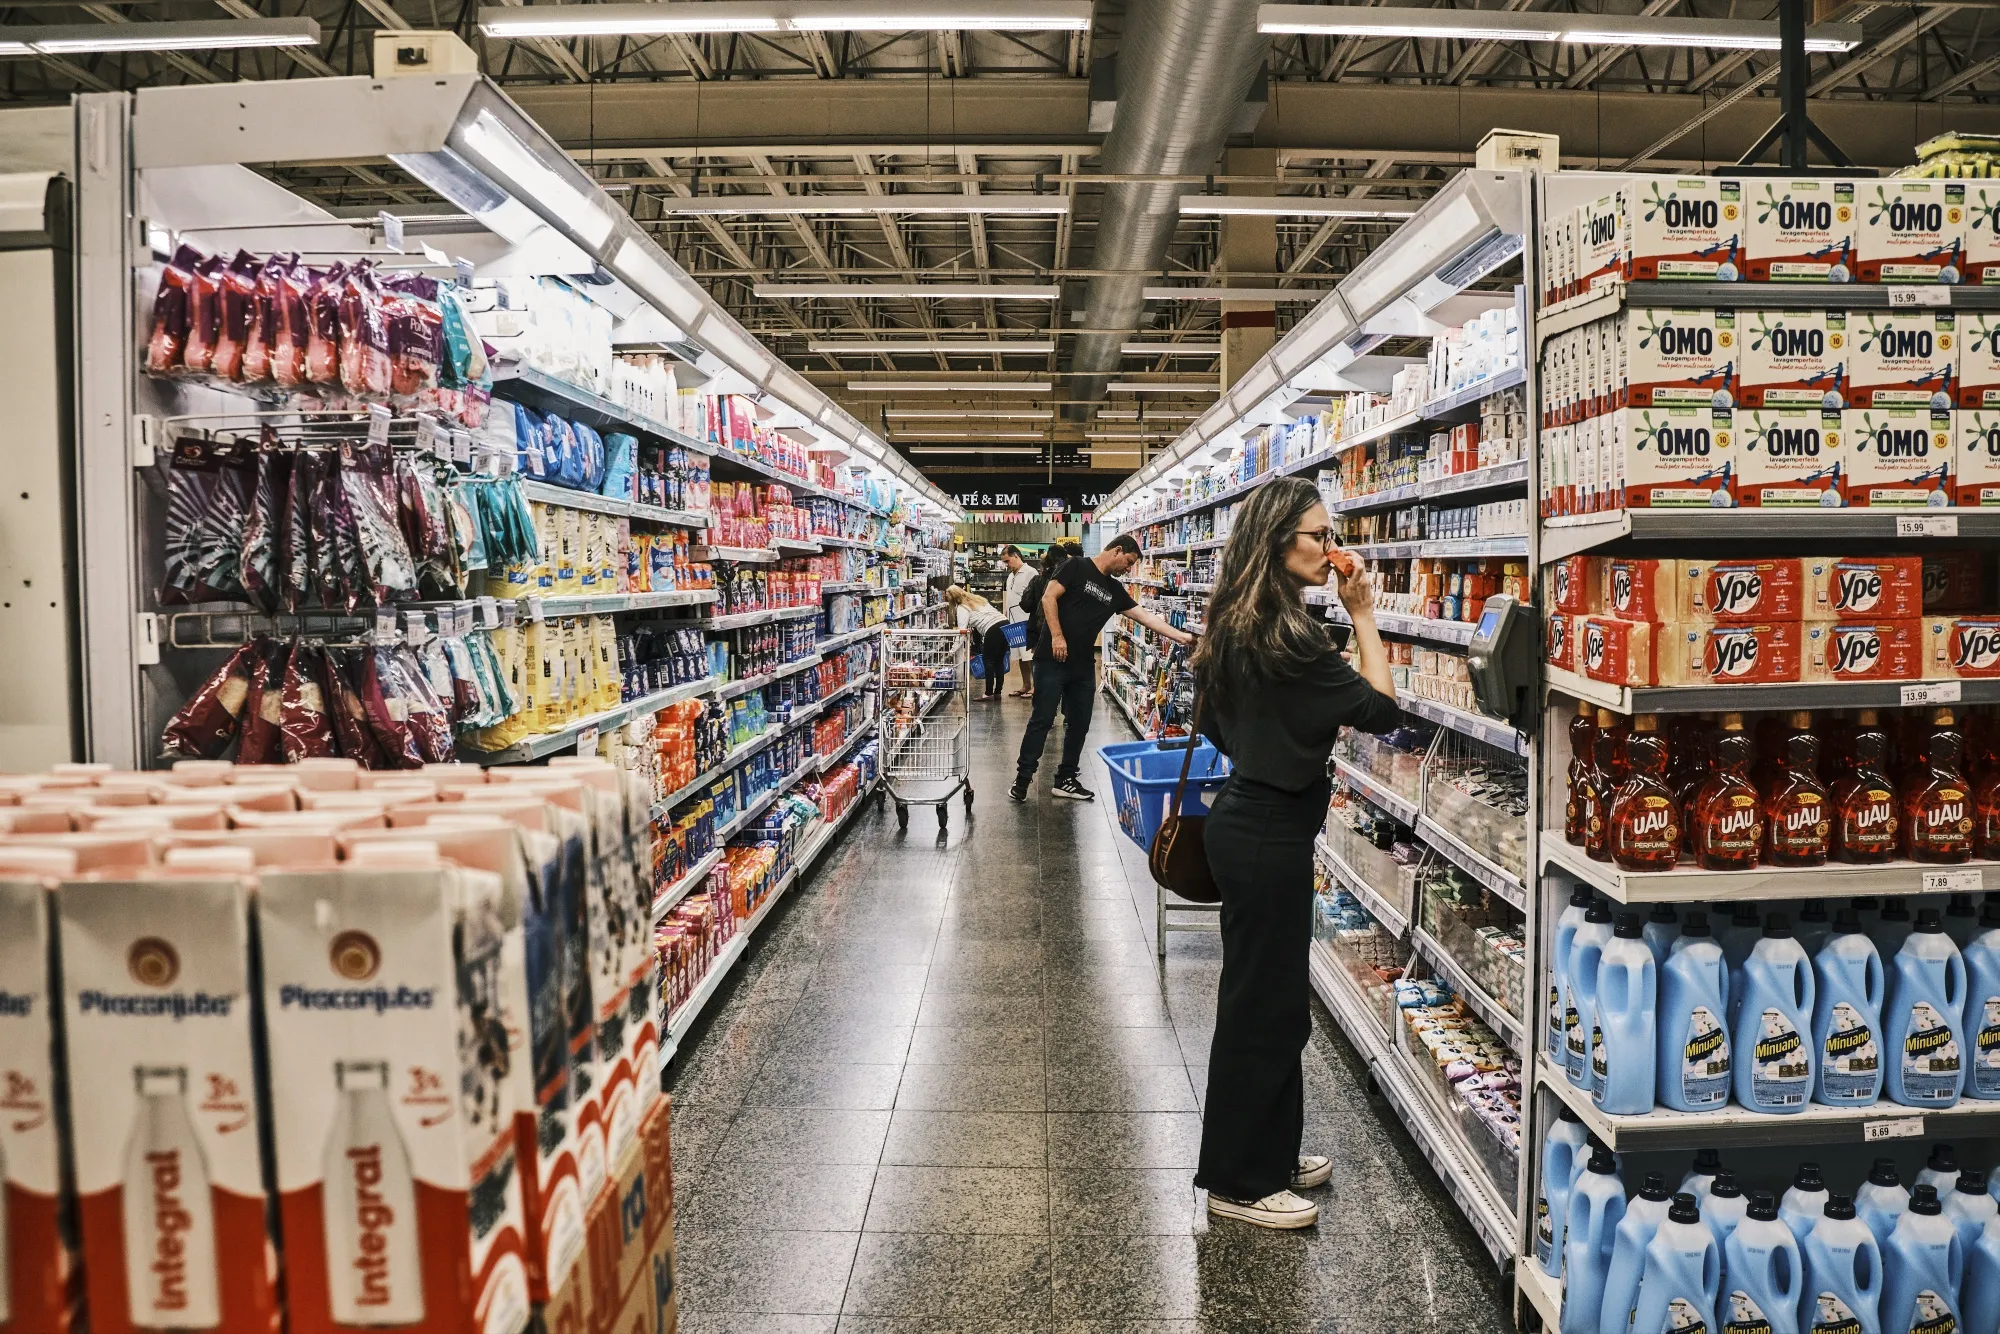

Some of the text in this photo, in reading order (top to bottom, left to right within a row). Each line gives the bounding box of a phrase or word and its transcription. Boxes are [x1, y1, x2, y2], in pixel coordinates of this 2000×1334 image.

[1893, 293, 1916, 303] 15.99
[982, 495, 992, 506] &
[995, 494, 1020, 506] EM
[1046, 499, 1059, 507] 02
[1902, 523, 1924, 533] 15.99
[1906, 691, 1928, 701] 13.99
[1634, 809, 1669, 835] UAU
[1721, 808, 1754, 834] UAU
[1787, 805, 1821, 831] UAU
[1858, 802, 1890, 828] UAU
[1928, 802, 1963, 827] UAU
[1721, 840, 1755, 848] PERFUMES
[1930, 878, 1948, 887] 7.89
[1685, 1029, 1724, 1059] Minuano
[1755, 1035, 1800, 1059] Minuano
[1826, 1030, 1870, 1052] Minuano
[1905, 1031, 1951, 1052] Minuano
[1871, 1127, 1889, 1137] 8.69
[145, 1148, 193, 1310] Integral
[345, 1143, 394, 1307] Integral
